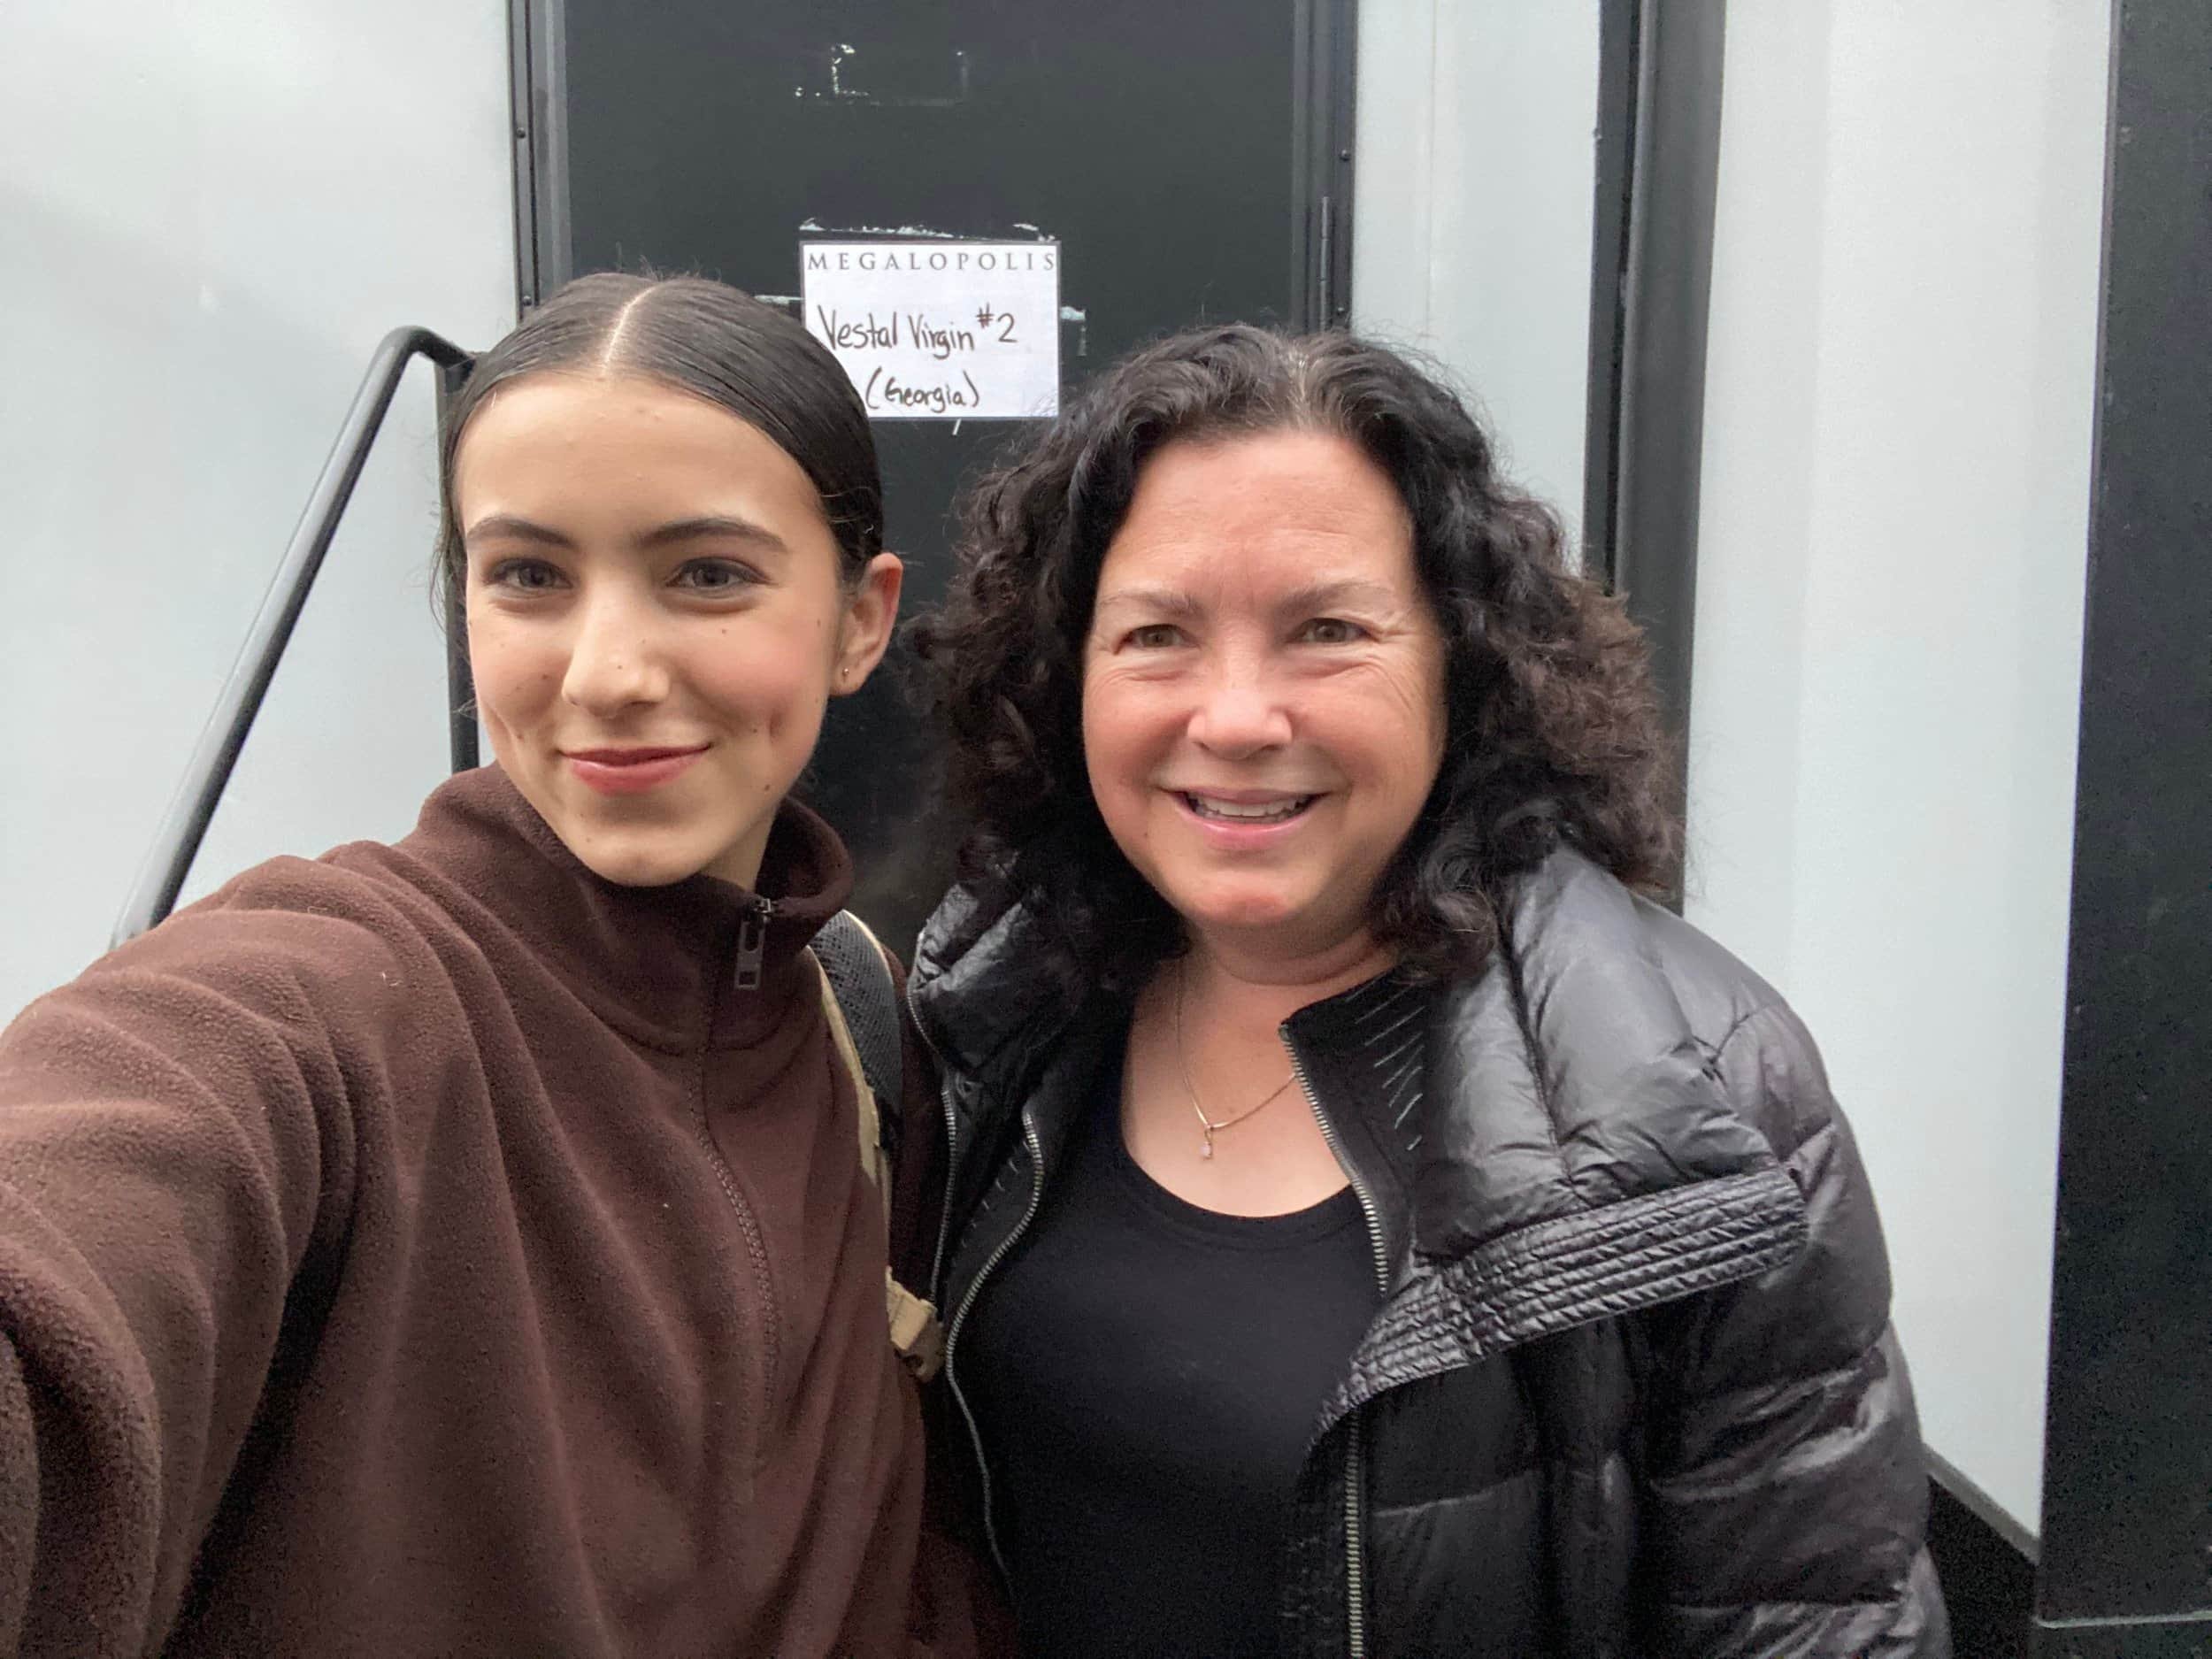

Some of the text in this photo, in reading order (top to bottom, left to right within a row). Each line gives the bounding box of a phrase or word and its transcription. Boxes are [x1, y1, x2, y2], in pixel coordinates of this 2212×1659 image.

[807, 251, 1055, 271] MEGALOPOLIS
[817, 303, 1018, 360] Vestal Virgin #2
[864, 365, 980, 414] (Georgia)
